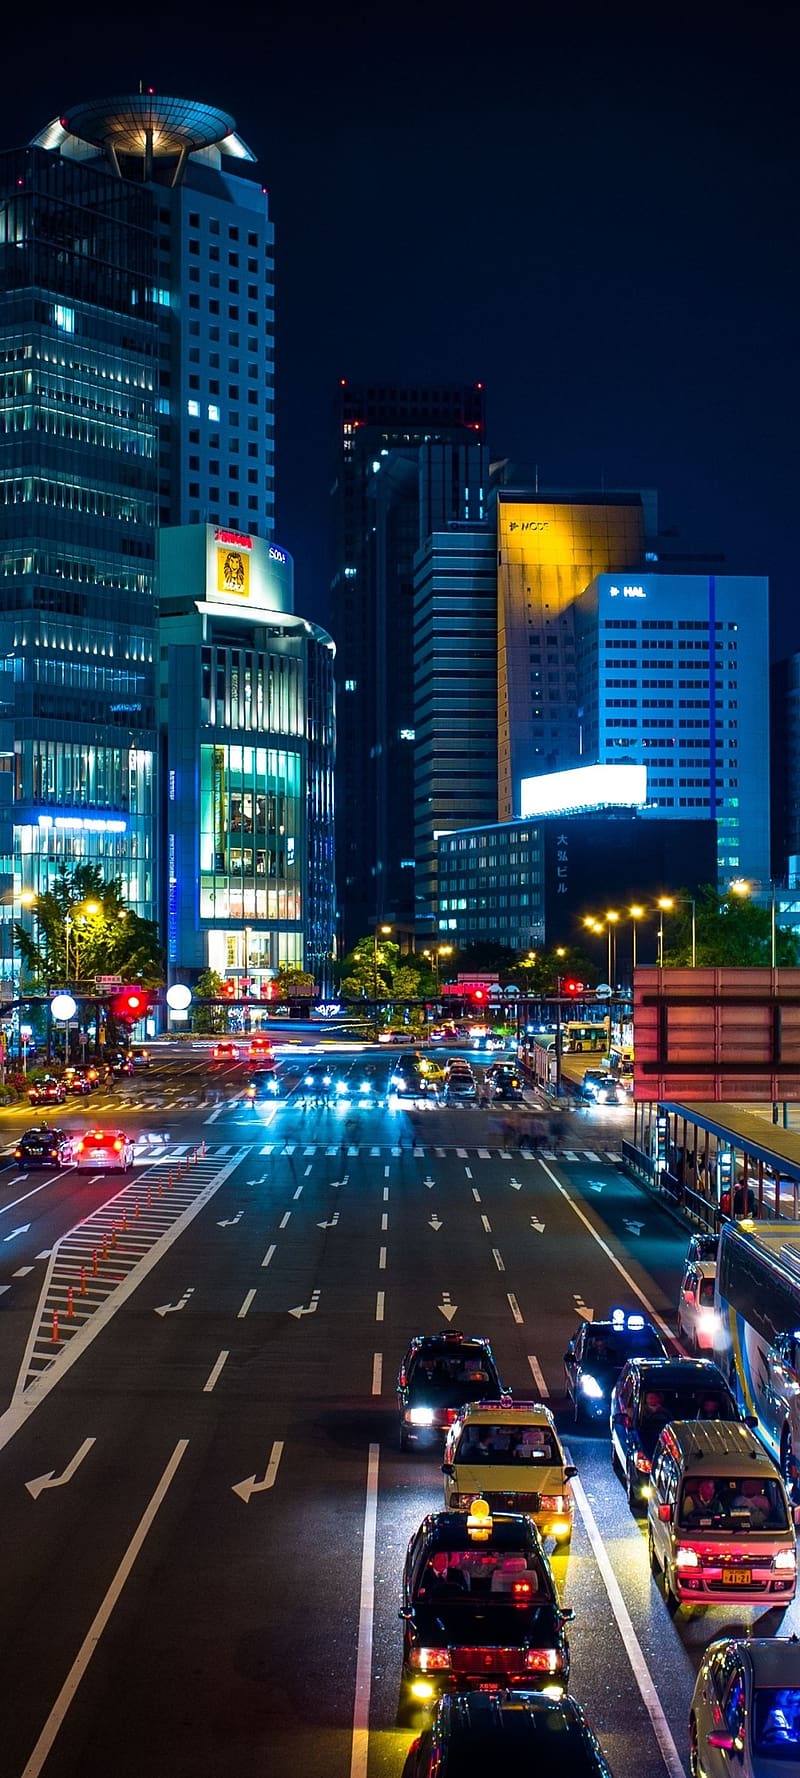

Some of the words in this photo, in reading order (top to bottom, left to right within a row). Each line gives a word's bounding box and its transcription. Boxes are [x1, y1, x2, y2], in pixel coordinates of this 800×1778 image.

[623, 586, 647, 598] HAL
[556, 833, 569, 894] 大弘ビル
